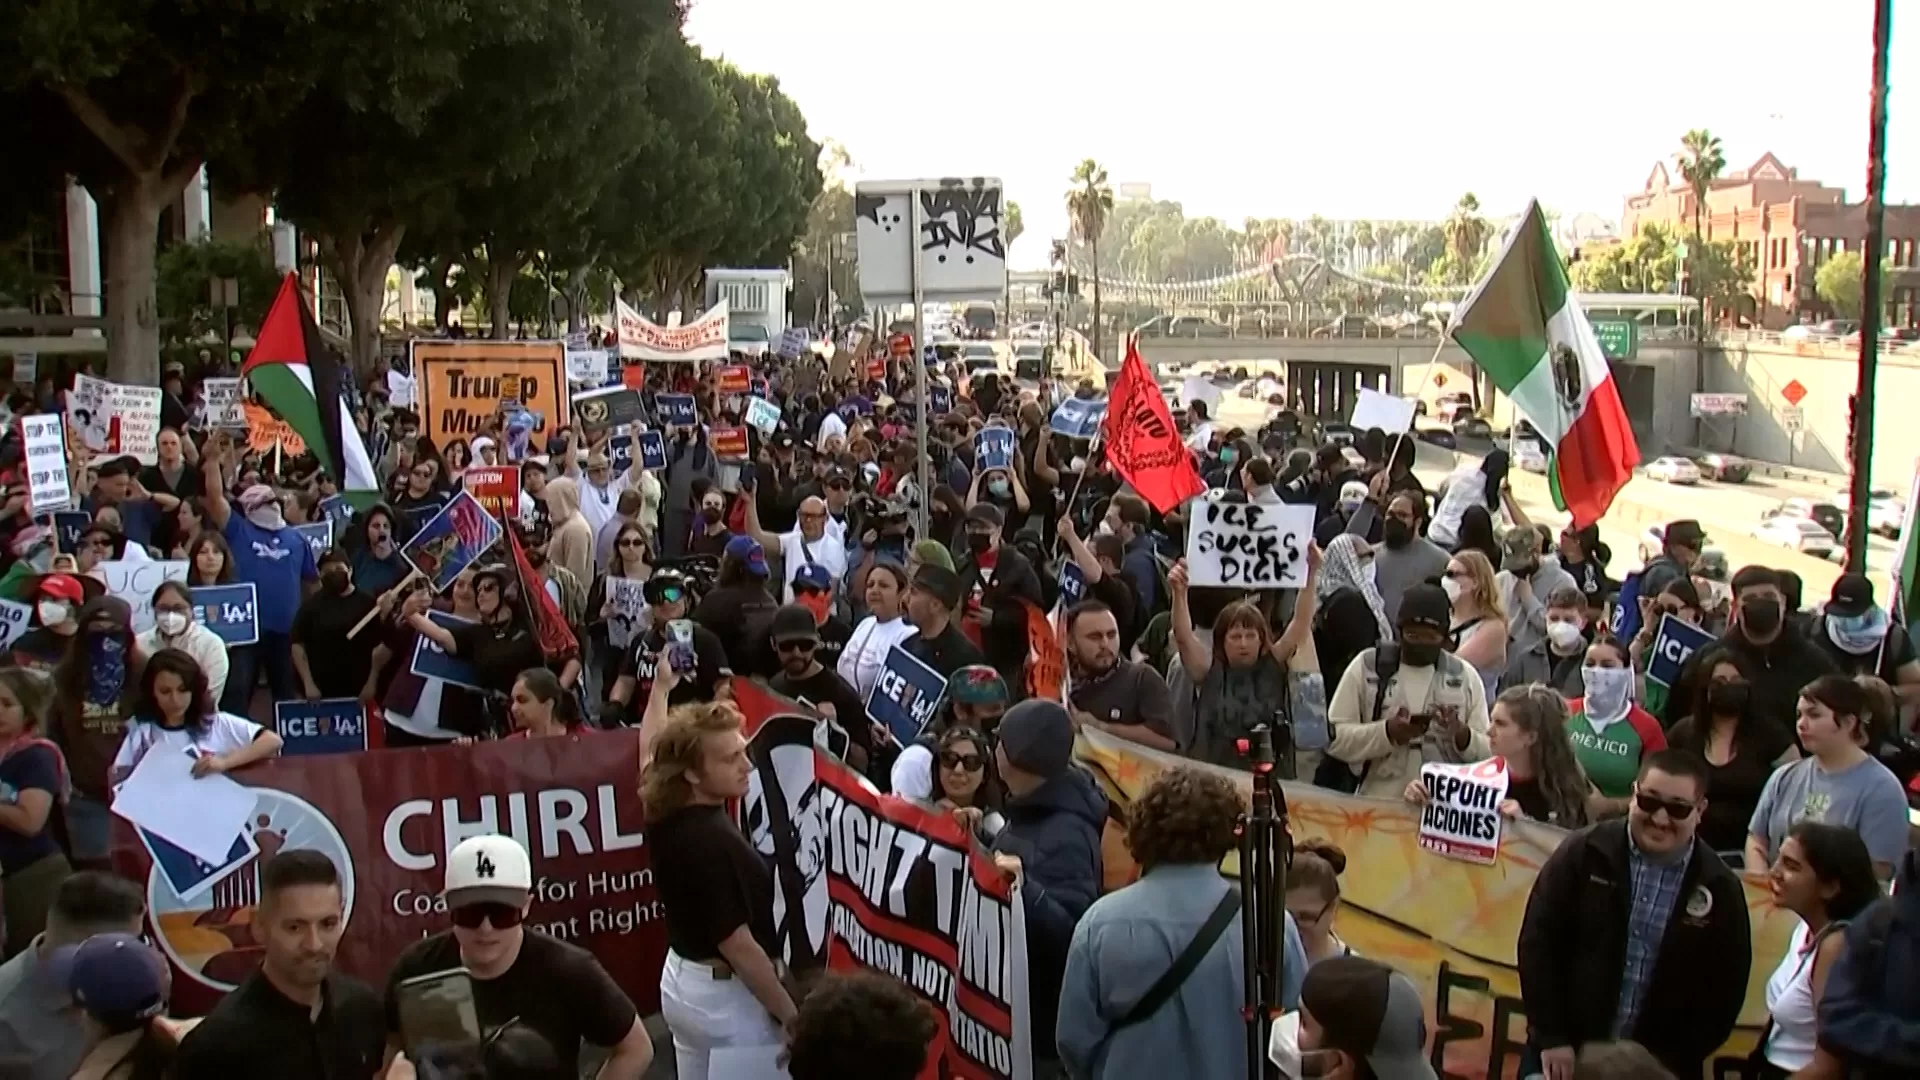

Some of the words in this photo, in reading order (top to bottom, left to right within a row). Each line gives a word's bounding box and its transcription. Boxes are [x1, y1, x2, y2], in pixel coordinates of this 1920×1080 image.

[446, 369, 538, 405] Trup
[1207, 503, 1277, 531] ICE
[1198, 530, 1299, 562] SUCKS
[104, 565, 181, 595] UCK
[1220, 553, 1296, 583] DICK
[878, 665, 907, 702] ICE
[281, 717, 319, 738] ICE
[333, 713, 362, 736] LA!
[1570, 731, 1628, 756] MEXICO
[383, 784, 644, 870] CHIRL
[1423, 804, 1496, 840] ACIONES
[476, 850, 496, 878] LA
[393, 889, 448, 916] Coa
[537, 876, 577, 905] for
[588, 867, 653, 897] Hum
